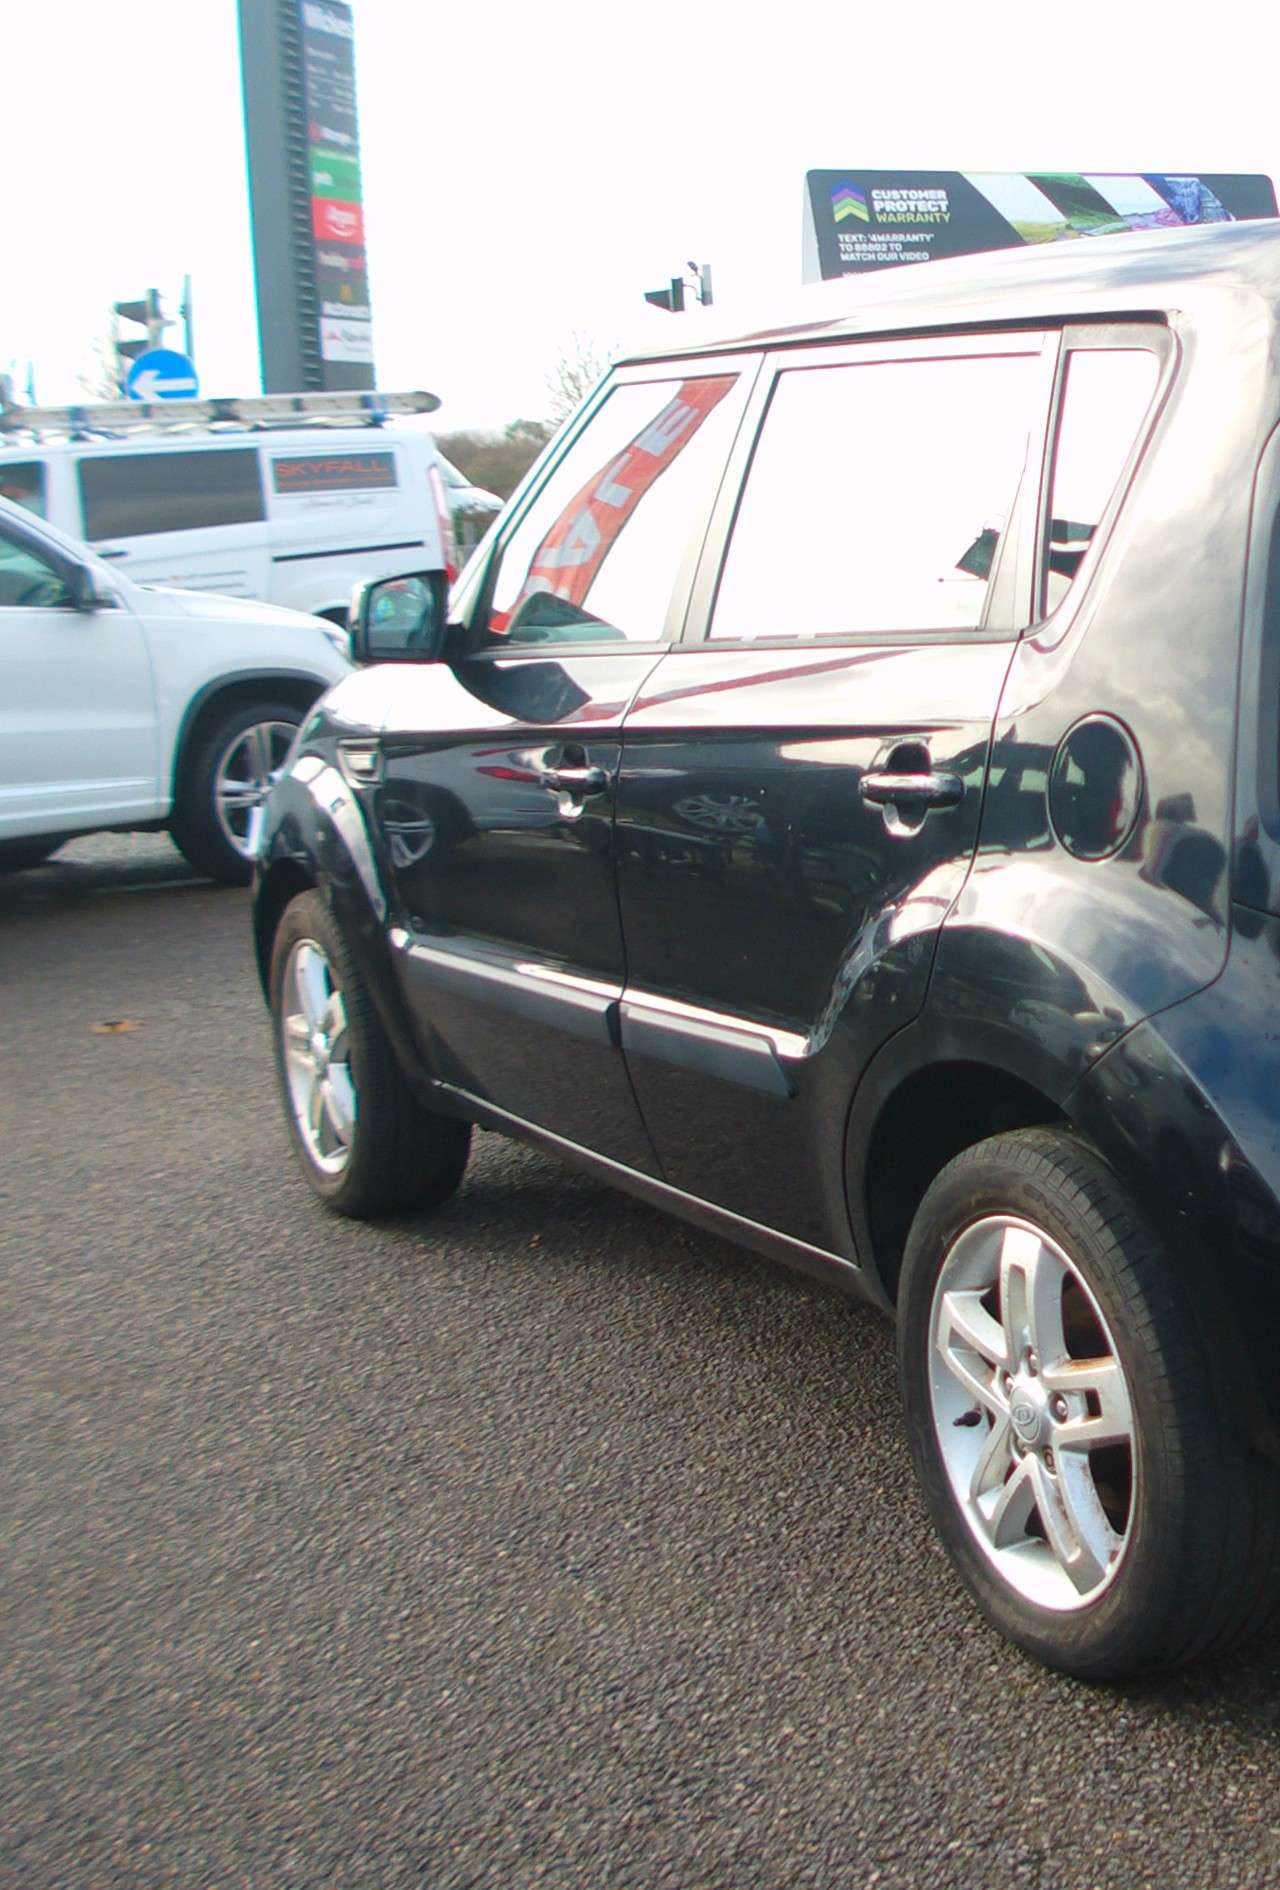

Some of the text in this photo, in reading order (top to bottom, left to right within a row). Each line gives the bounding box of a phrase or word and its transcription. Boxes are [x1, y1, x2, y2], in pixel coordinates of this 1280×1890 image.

[871, 188, 947, 200] CUSTOMER
[873, 200, 948, 212] PROTECT
[876, 212, 951, 223] WARRANTY
[840, 243, 853, 252] TO
[889, 243, 903, 252] TO
[841, 252, 875, 262] WATCH
[900, 252, 930, 261] VIDEO
